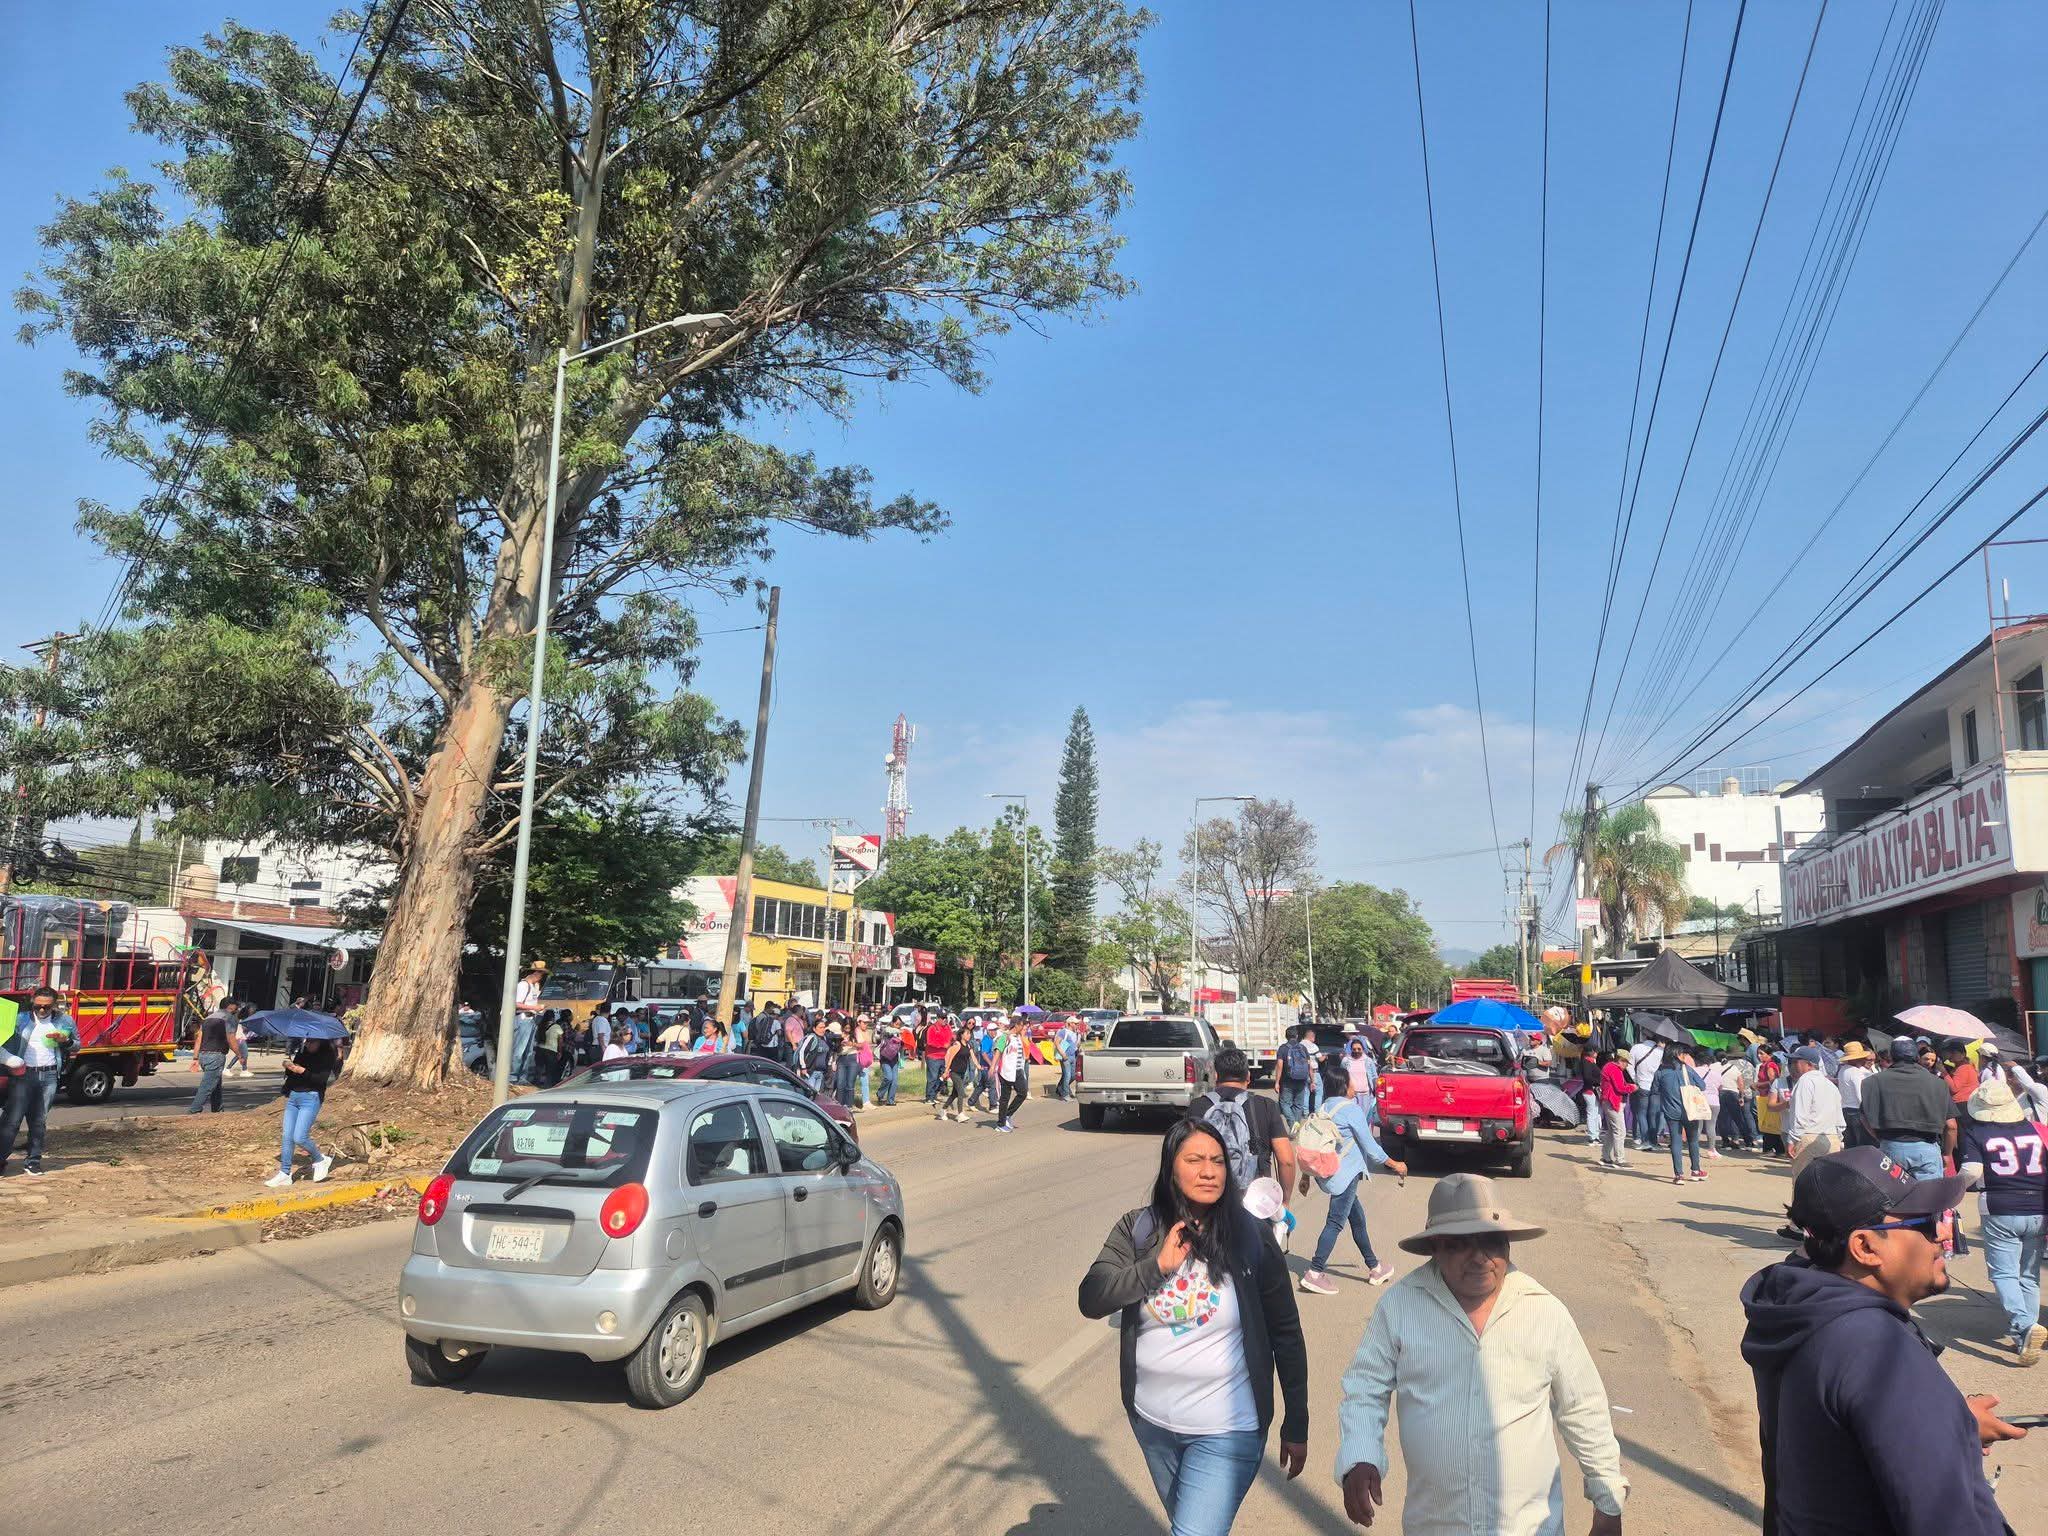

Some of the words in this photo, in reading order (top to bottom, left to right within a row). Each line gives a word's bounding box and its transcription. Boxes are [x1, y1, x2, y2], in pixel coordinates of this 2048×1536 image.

[1789, 851, 1850, 920] TAQUERIA
[708, 920, 730, 930] One
[1985, 1135, 2043, 1175] 37
